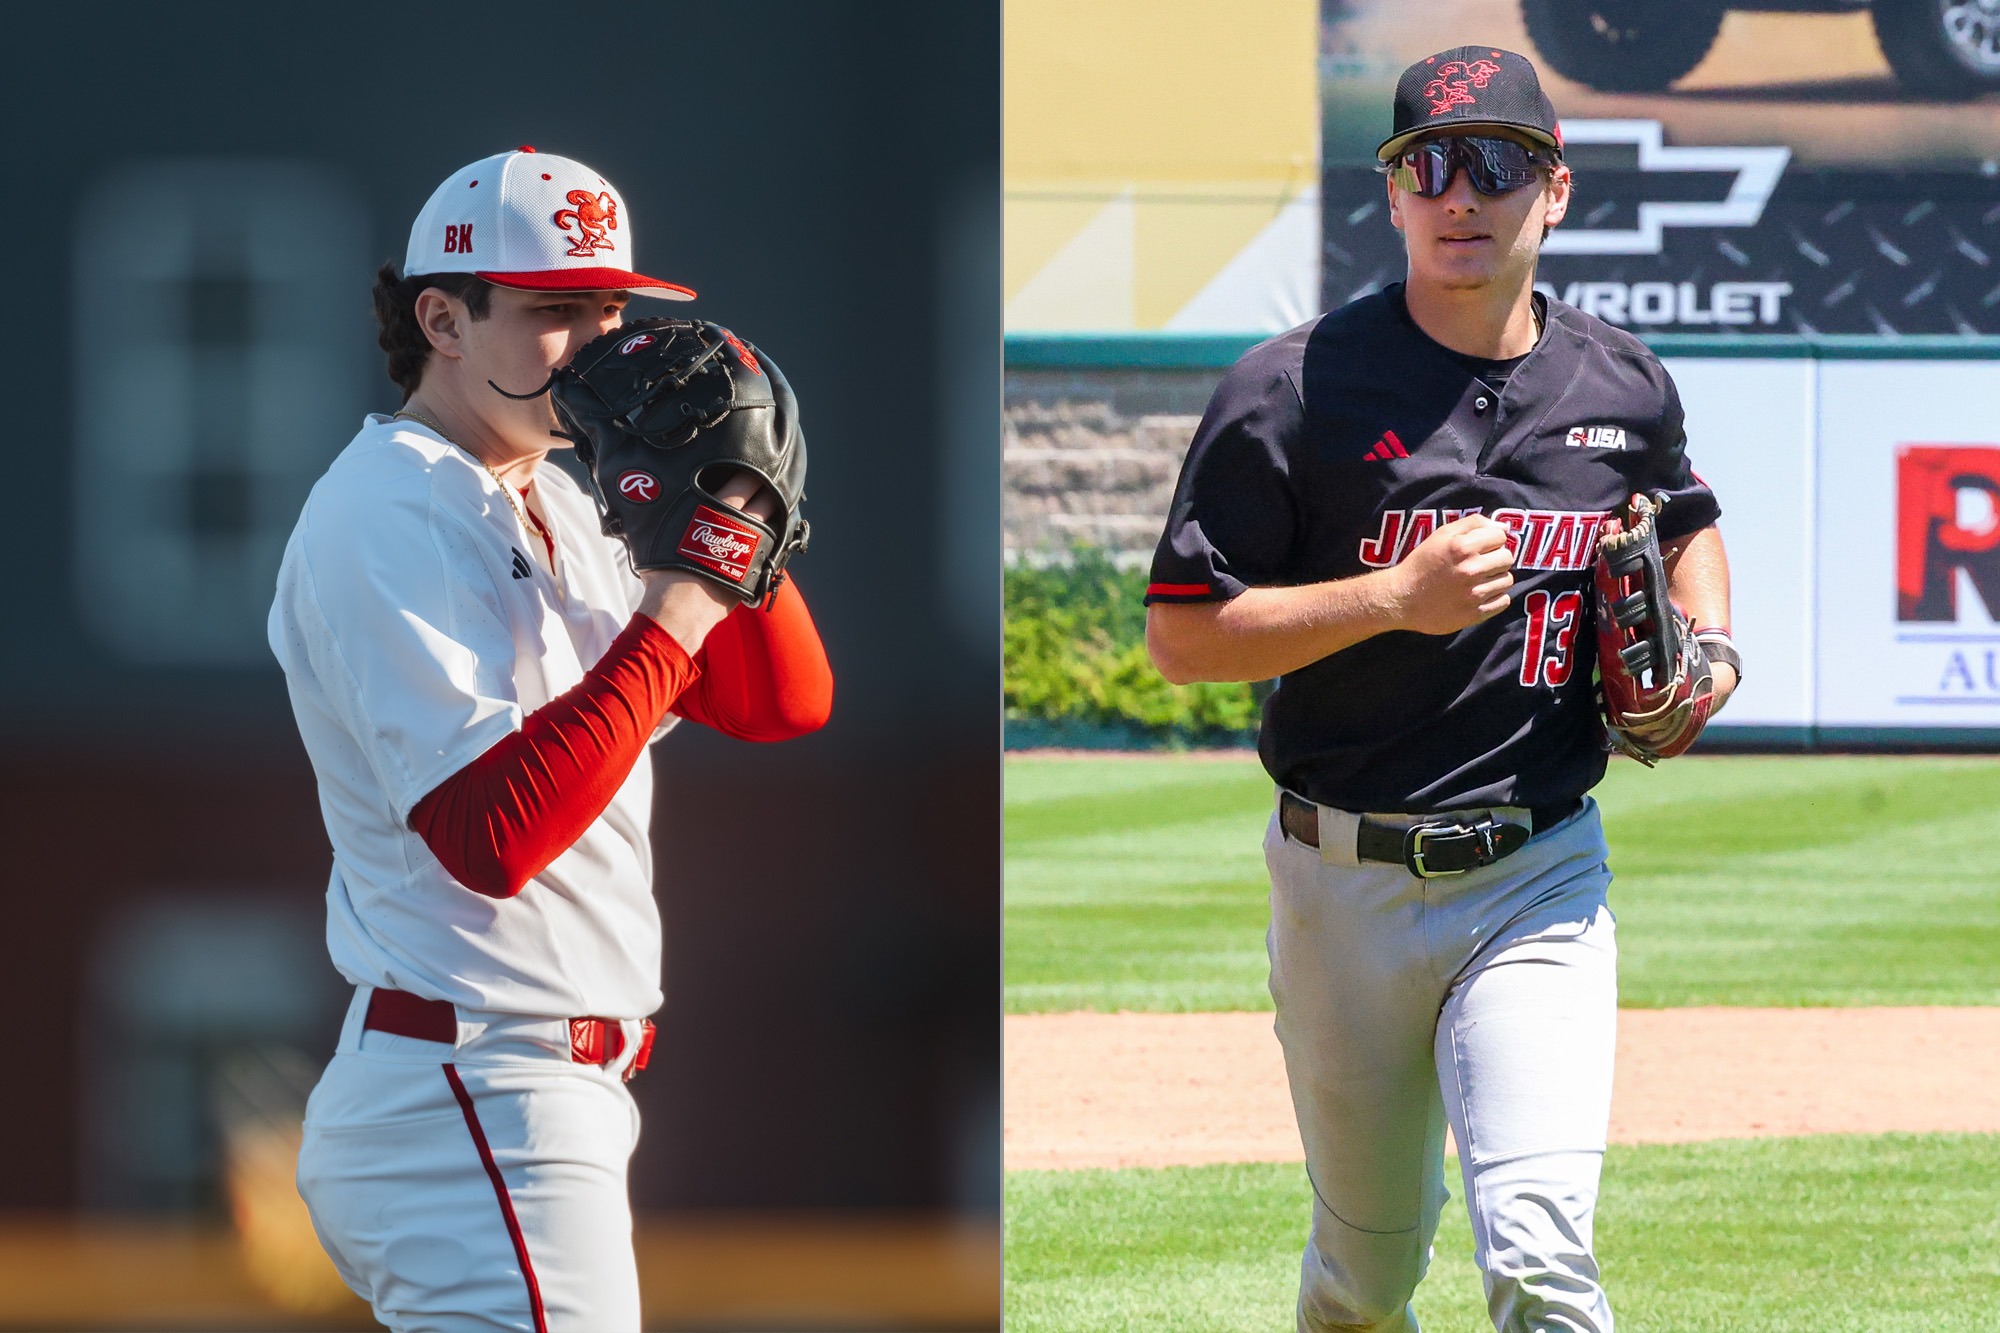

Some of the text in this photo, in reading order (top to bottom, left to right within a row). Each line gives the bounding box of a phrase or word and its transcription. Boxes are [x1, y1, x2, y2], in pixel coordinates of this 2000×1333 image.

[444, 223, 473, 254] BK
[620, 473, 655, 500] R
[692, 525, 751, 559] Rawlings
[1519, 589, 1584, 688] 13
